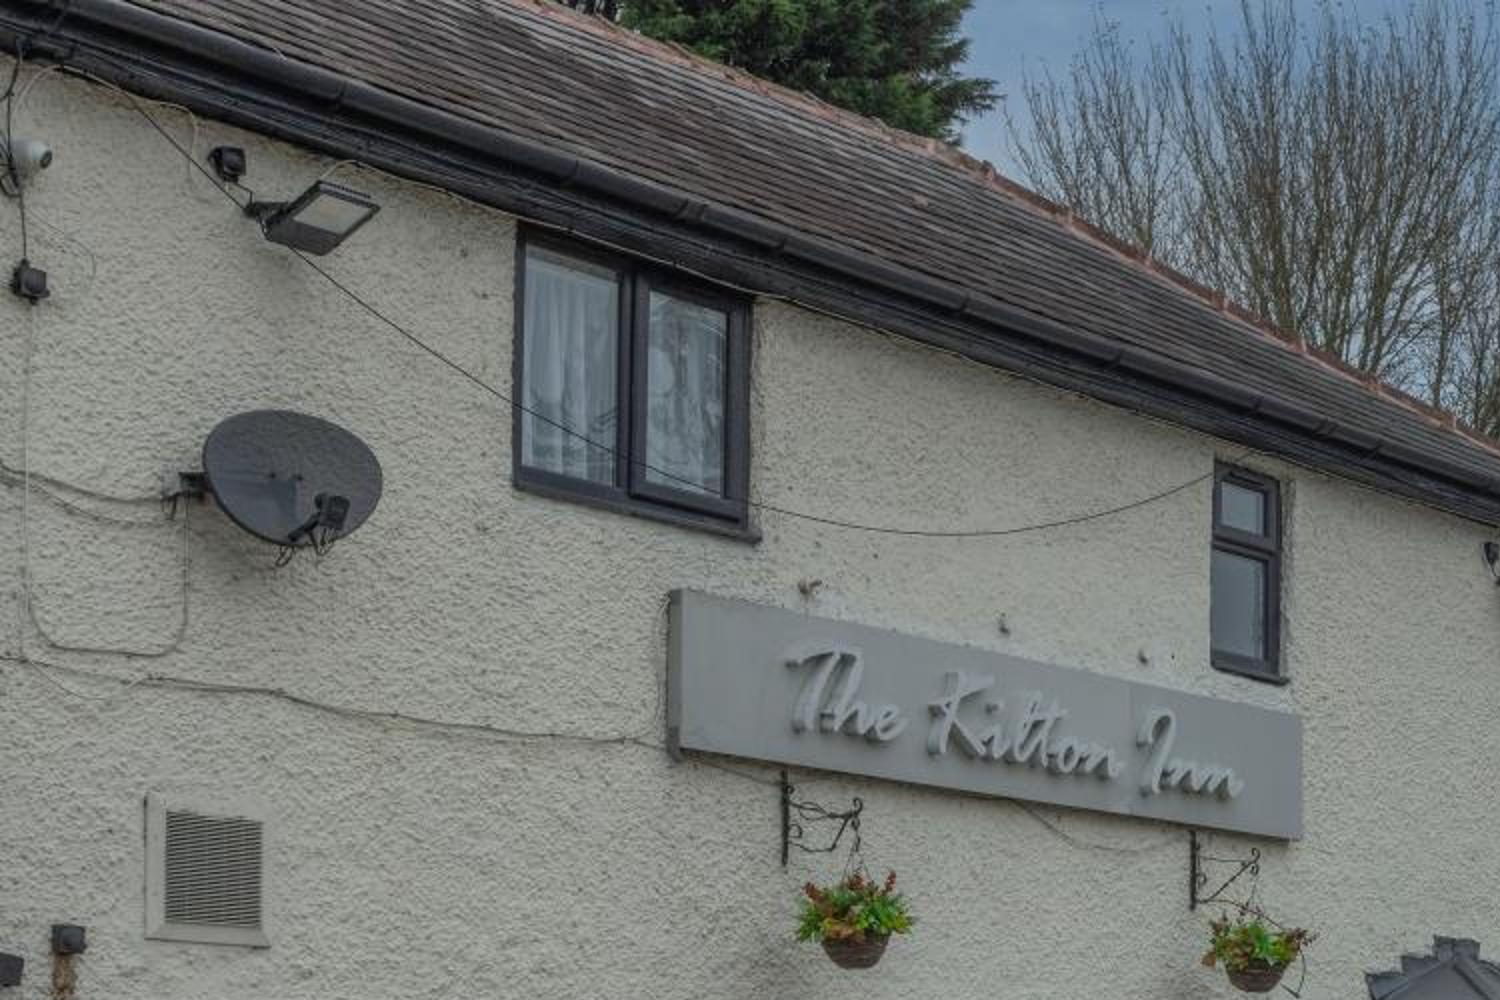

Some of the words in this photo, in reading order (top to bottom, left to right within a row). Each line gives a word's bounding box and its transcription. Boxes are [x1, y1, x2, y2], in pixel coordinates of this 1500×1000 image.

[785, 648, 908, 745] The
[928, 671, 1124, 779] Kilton
[1136, 705, 1246, 798] Inn
